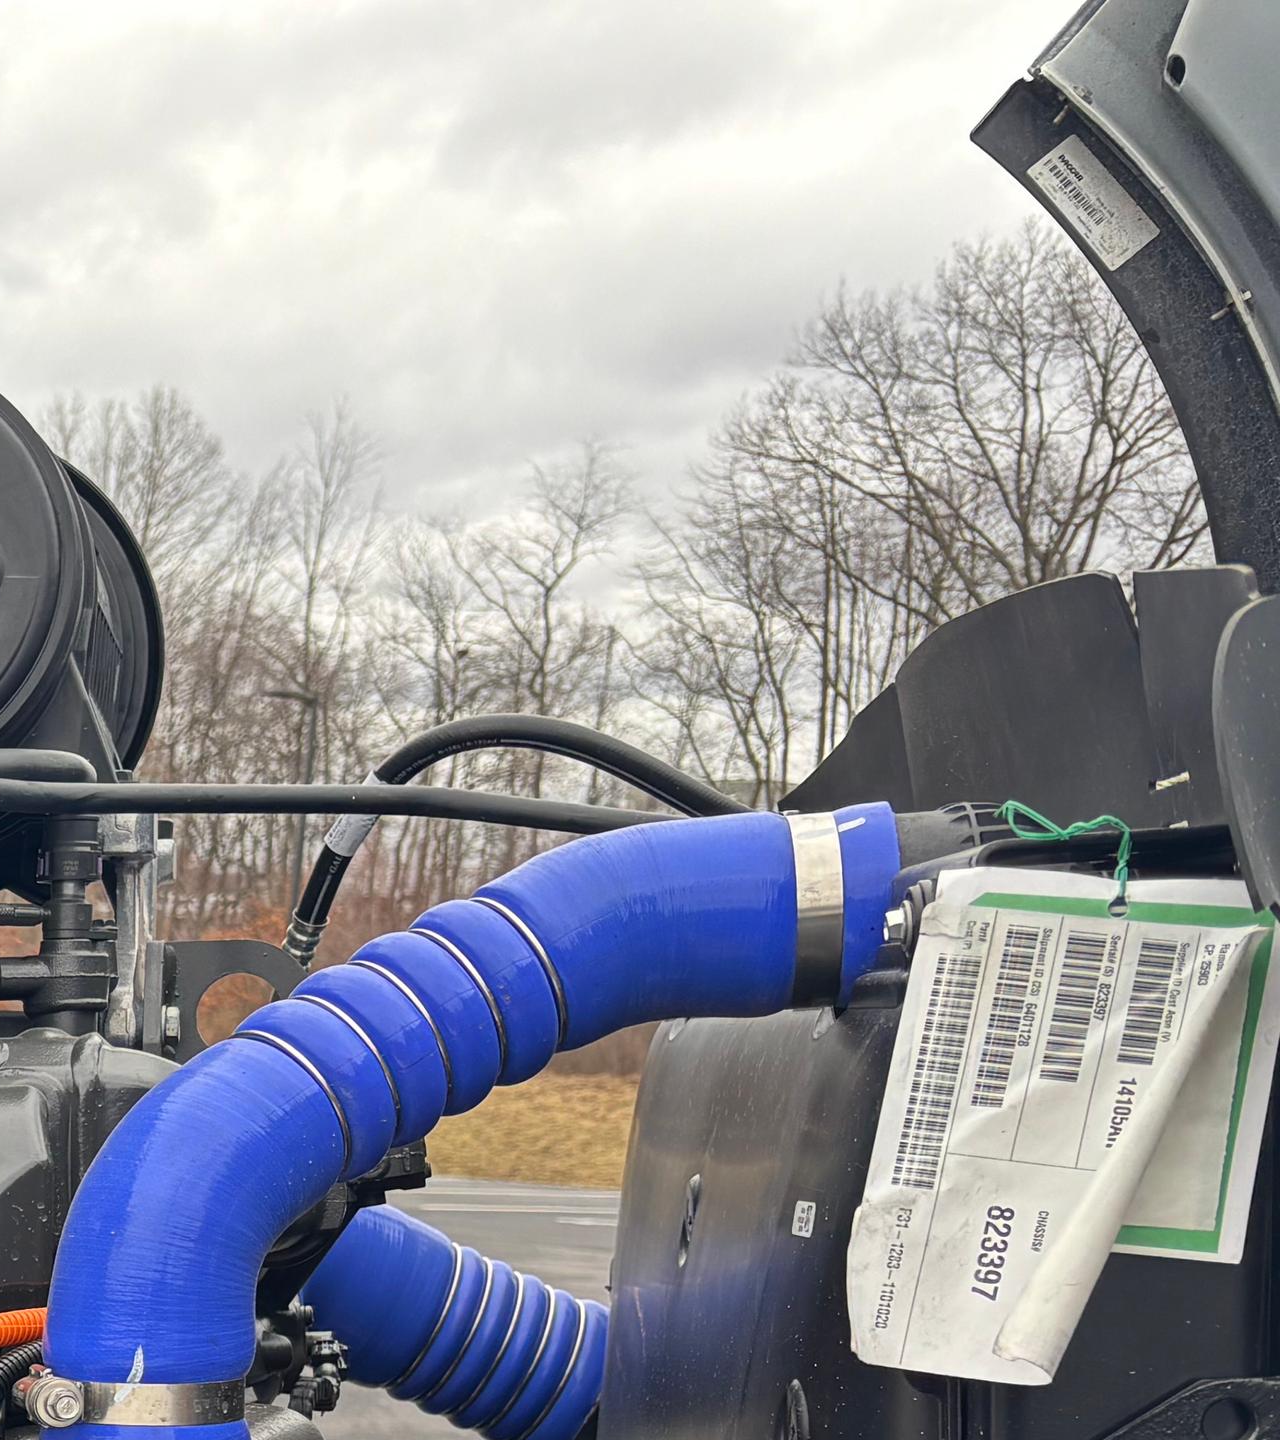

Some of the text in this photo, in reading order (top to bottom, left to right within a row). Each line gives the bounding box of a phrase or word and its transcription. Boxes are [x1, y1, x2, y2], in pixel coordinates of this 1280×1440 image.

[1058, 153, 1084, 182] PACCAR
[1017, 927, 1053, 1047] Shipment ID (2S) 6401128
[1093, 935, 1121, 1022] Serial# (S) 823397
[1163, 942, 1190, 1030] Supplier ID Assn
[971, 1205, 1015, 1301] 823397
